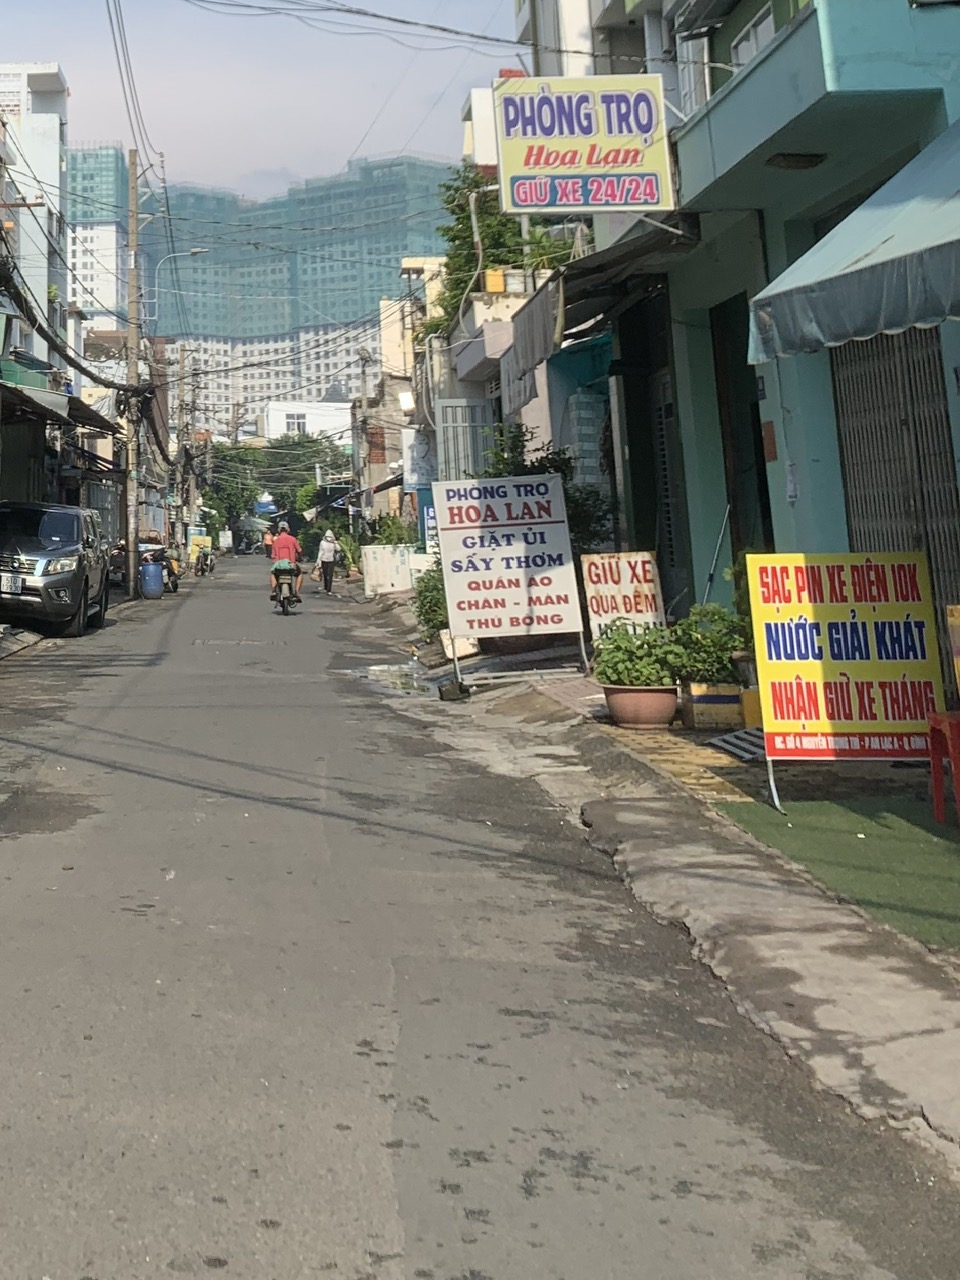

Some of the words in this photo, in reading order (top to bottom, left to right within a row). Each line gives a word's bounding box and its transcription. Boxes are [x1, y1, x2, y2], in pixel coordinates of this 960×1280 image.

[502, 84, 593, 138] PHÒNG
[600, 91, 656, 146] TRỌ
[523, 144, 581, 168] Hoa
[586, 143, 642, 167] Lan
[514, 175, 551, 205] GIỮ
[556, 178, 583, 204] XE
[588, 176, 658, 205] 24/24
[445, 484, 508, 502] PHÒNG
[513, 482, 549, 499] TRỌ
[447, 504, 500, 525] HOA
[504, 500, 552, 521] LAN
[462, 531, 515, 551] GIẶT
[522, 527, 547, 546] ỦI
[451, 553, 494, 573] SẤY
[501, 552, 565, 570] THƠM
[627, 560, 655, 584] XE
[758, 565, 792, 613] SẠC
[794, 565, 824, 604] PIN
[826, 564, 849, 603] XE
[850, 558, 889, 612] ĐIỆN
[590, 595, 620, 617] QUA
[622, 589, 658, 614] ĐÊM
[764, 615, 824, 661] NƯỚC
[827, 609, 871, 661] GIẢI
[874, 613, 927, 660] KHÁT
[770, 674, 820, 730] NHẬN
[855, 681, 878, 721] XE
[878, 674, 936, 721] THÁNG
